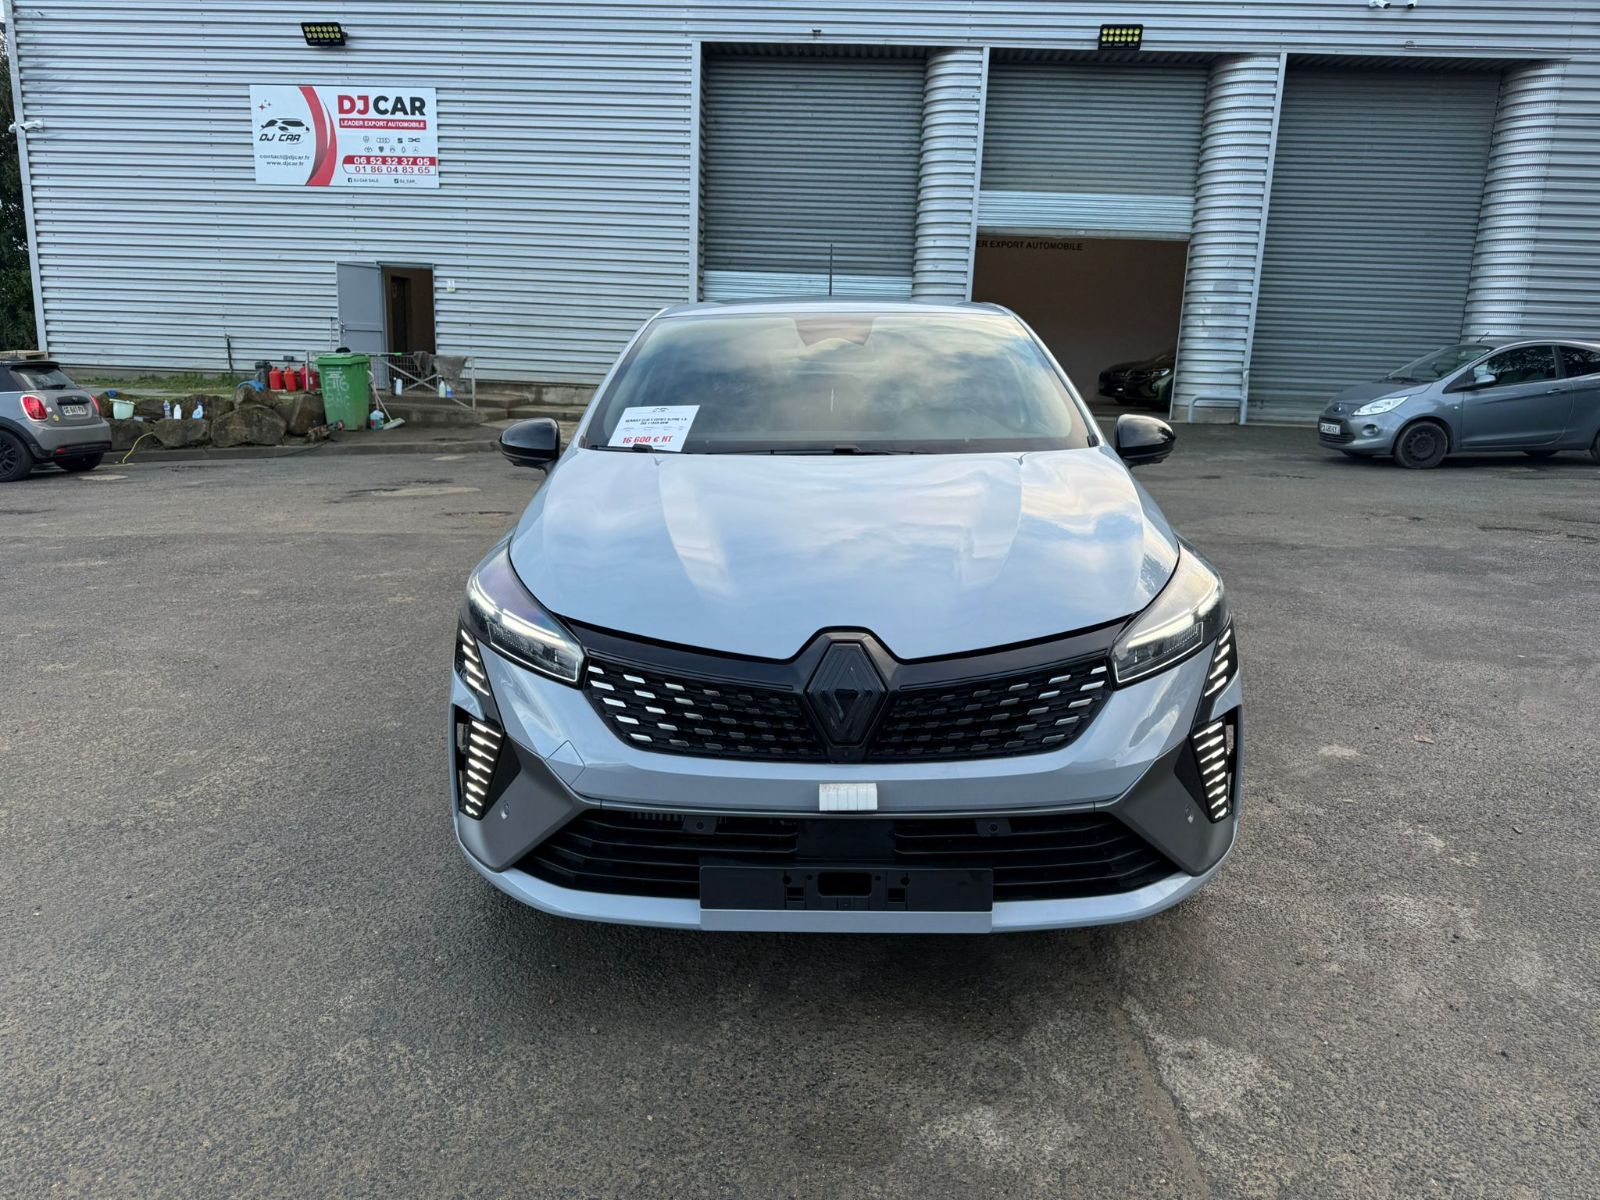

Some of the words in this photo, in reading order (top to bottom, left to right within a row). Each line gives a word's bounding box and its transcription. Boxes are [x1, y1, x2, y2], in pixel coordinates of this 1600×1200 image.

[337, 94, 370, 115] DJ
[372, 95, 426, 116] CAR
[364, 120, 387, 128] EXPORT
[259, 134, 276, 142] DJ
[278, 134, 302, 142] CAR
[990, 240, 1024, 248] EXPORT
[1026, 241, 1083, 250] AUTOMOBILE
